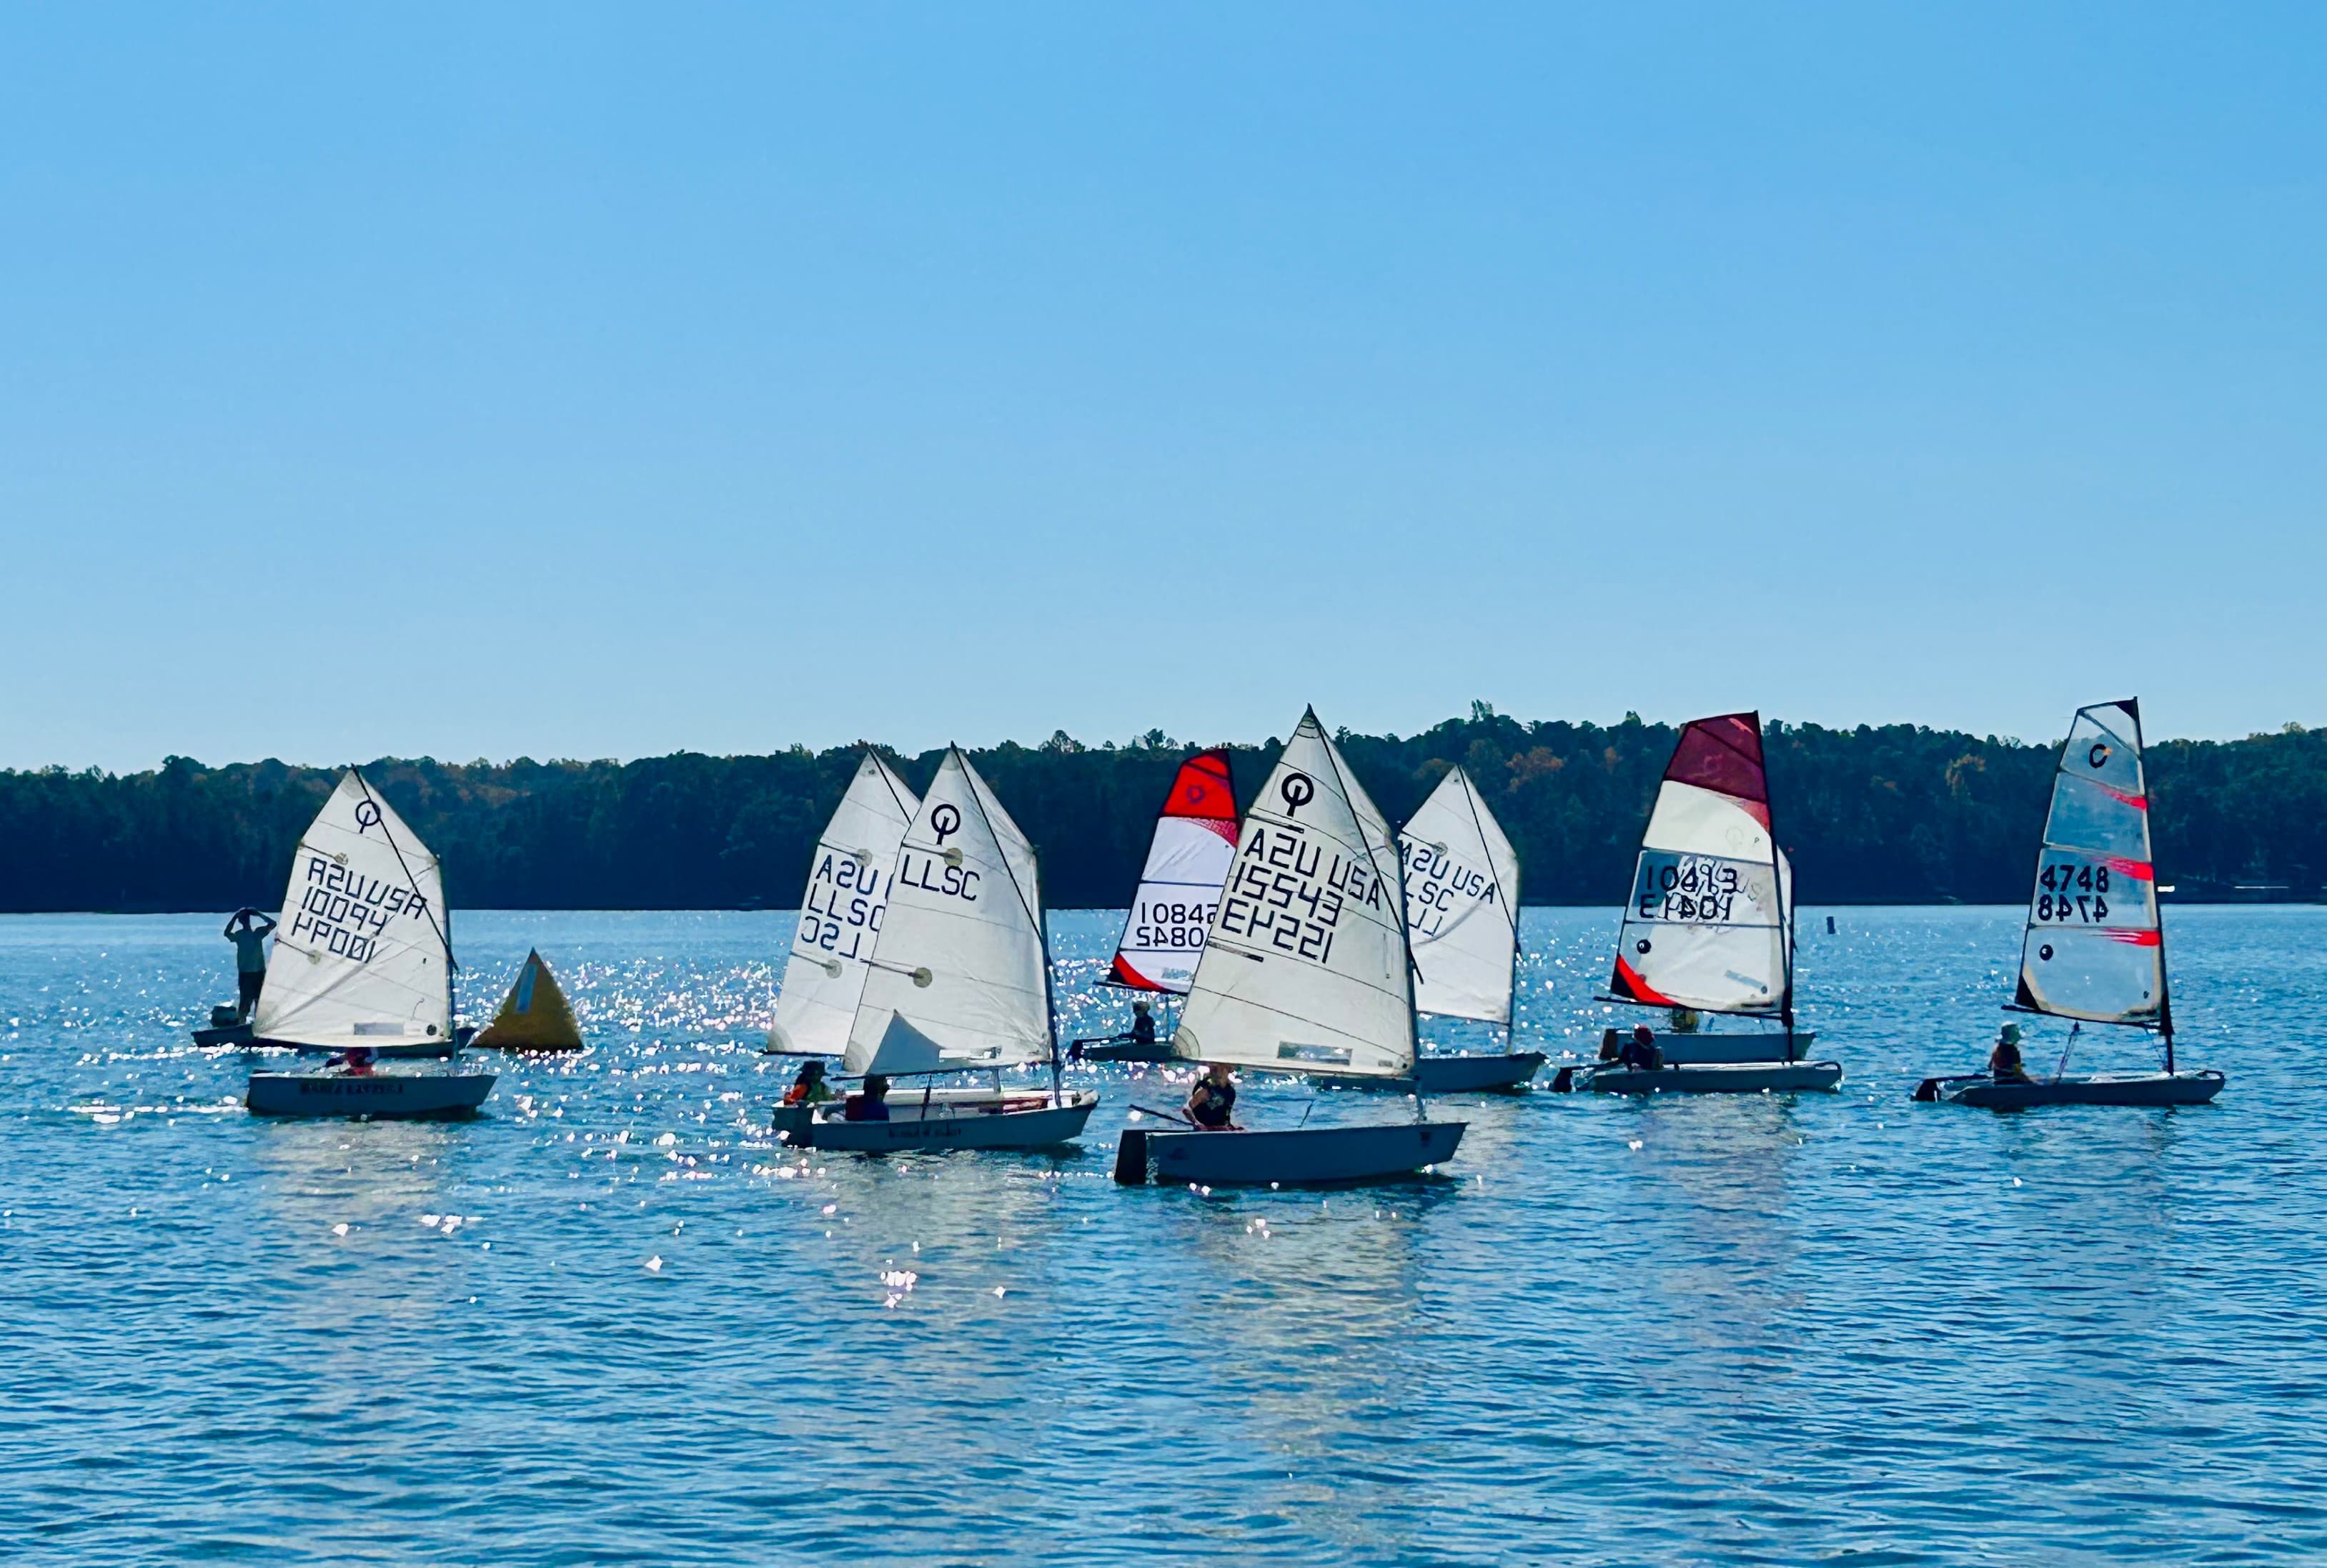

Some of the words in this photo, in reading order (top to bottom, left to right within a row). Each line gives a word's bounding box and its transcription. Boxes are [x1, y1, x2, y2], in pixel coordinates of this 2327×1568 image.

[365, 880, 427, 919] USA
[900, 855, 980, 900] LLSC
[1232, 862, 1343, 926] 15543
[1328, 855, 1379, 910] USA
[1406, 873, 1454, 911] LSC
[1452, 866, 1495, 904] USA
[2040, 865, 2109, 893] 4748
[302, 886, 387, 936] 10094
[808, 883, 885, 932] LLSC
